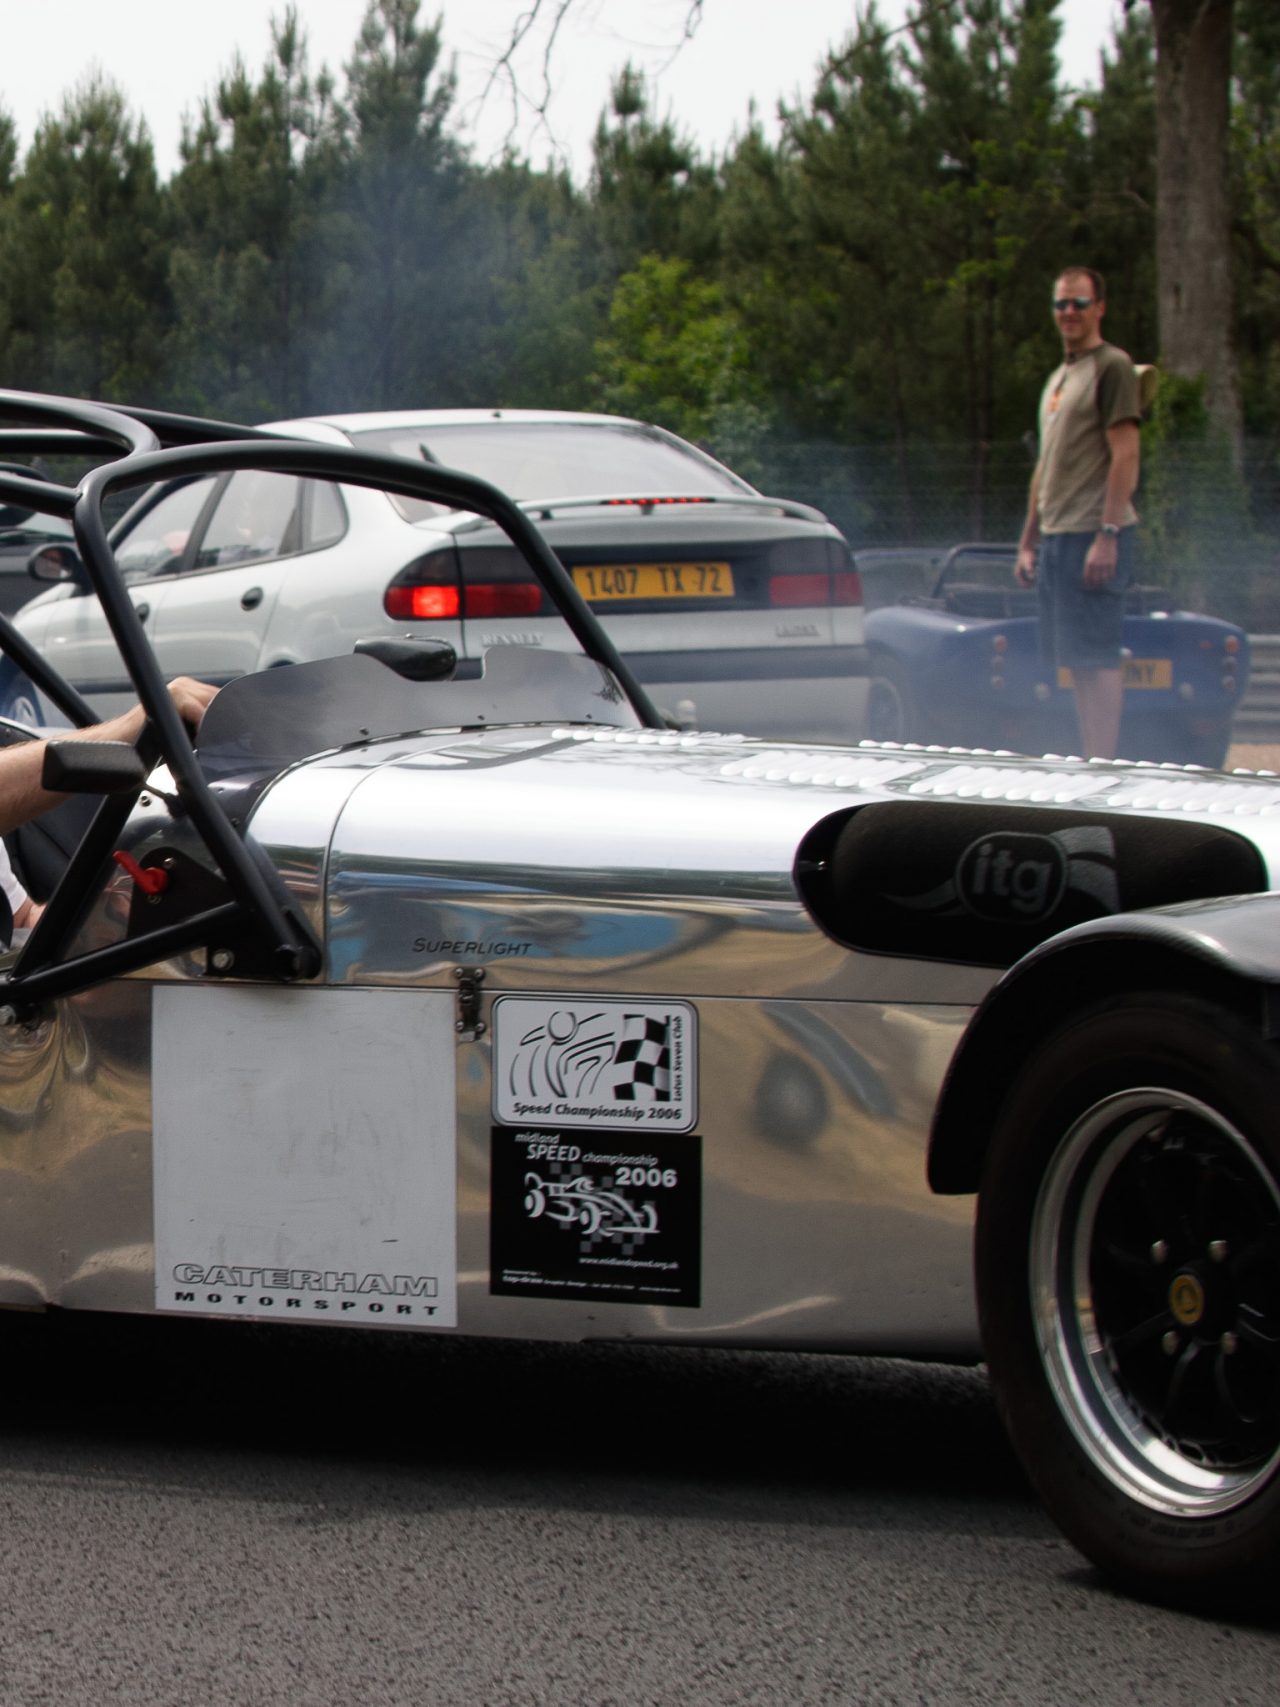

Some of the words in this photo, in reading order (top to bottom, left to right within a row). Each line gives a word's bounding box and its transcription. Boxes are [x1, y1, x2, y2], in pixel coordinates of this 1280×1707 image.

[585, 567, 639, 596] 1407
[658, 566, 685, 594] TX
[696, 565, 723, 592] 72
[973, 843, 1054, 913] itg
[412, 937, 533, 955] SUPERLIGHT
[672, 1015, 682, 1039] Club
[673, 1042, 682, 1071] Seven
[673, 1074, 682, 1102] Lotus
[513, 1102, 551, 1116] Speed
[555, 1104, 645, 1121] Championship
[648, 1107, 682, 1120] 2006
[515, 1131, 560, 1144] midland
[526, 1144, 581, 1162] SPEED
[582, 1152, 658, 1167] championship
[615, 1167, 678, 1188] 2006
[172, 1262, 438, 1298] CATERHAM
[174, 1291, 439, 1316] MOTORSPORT
